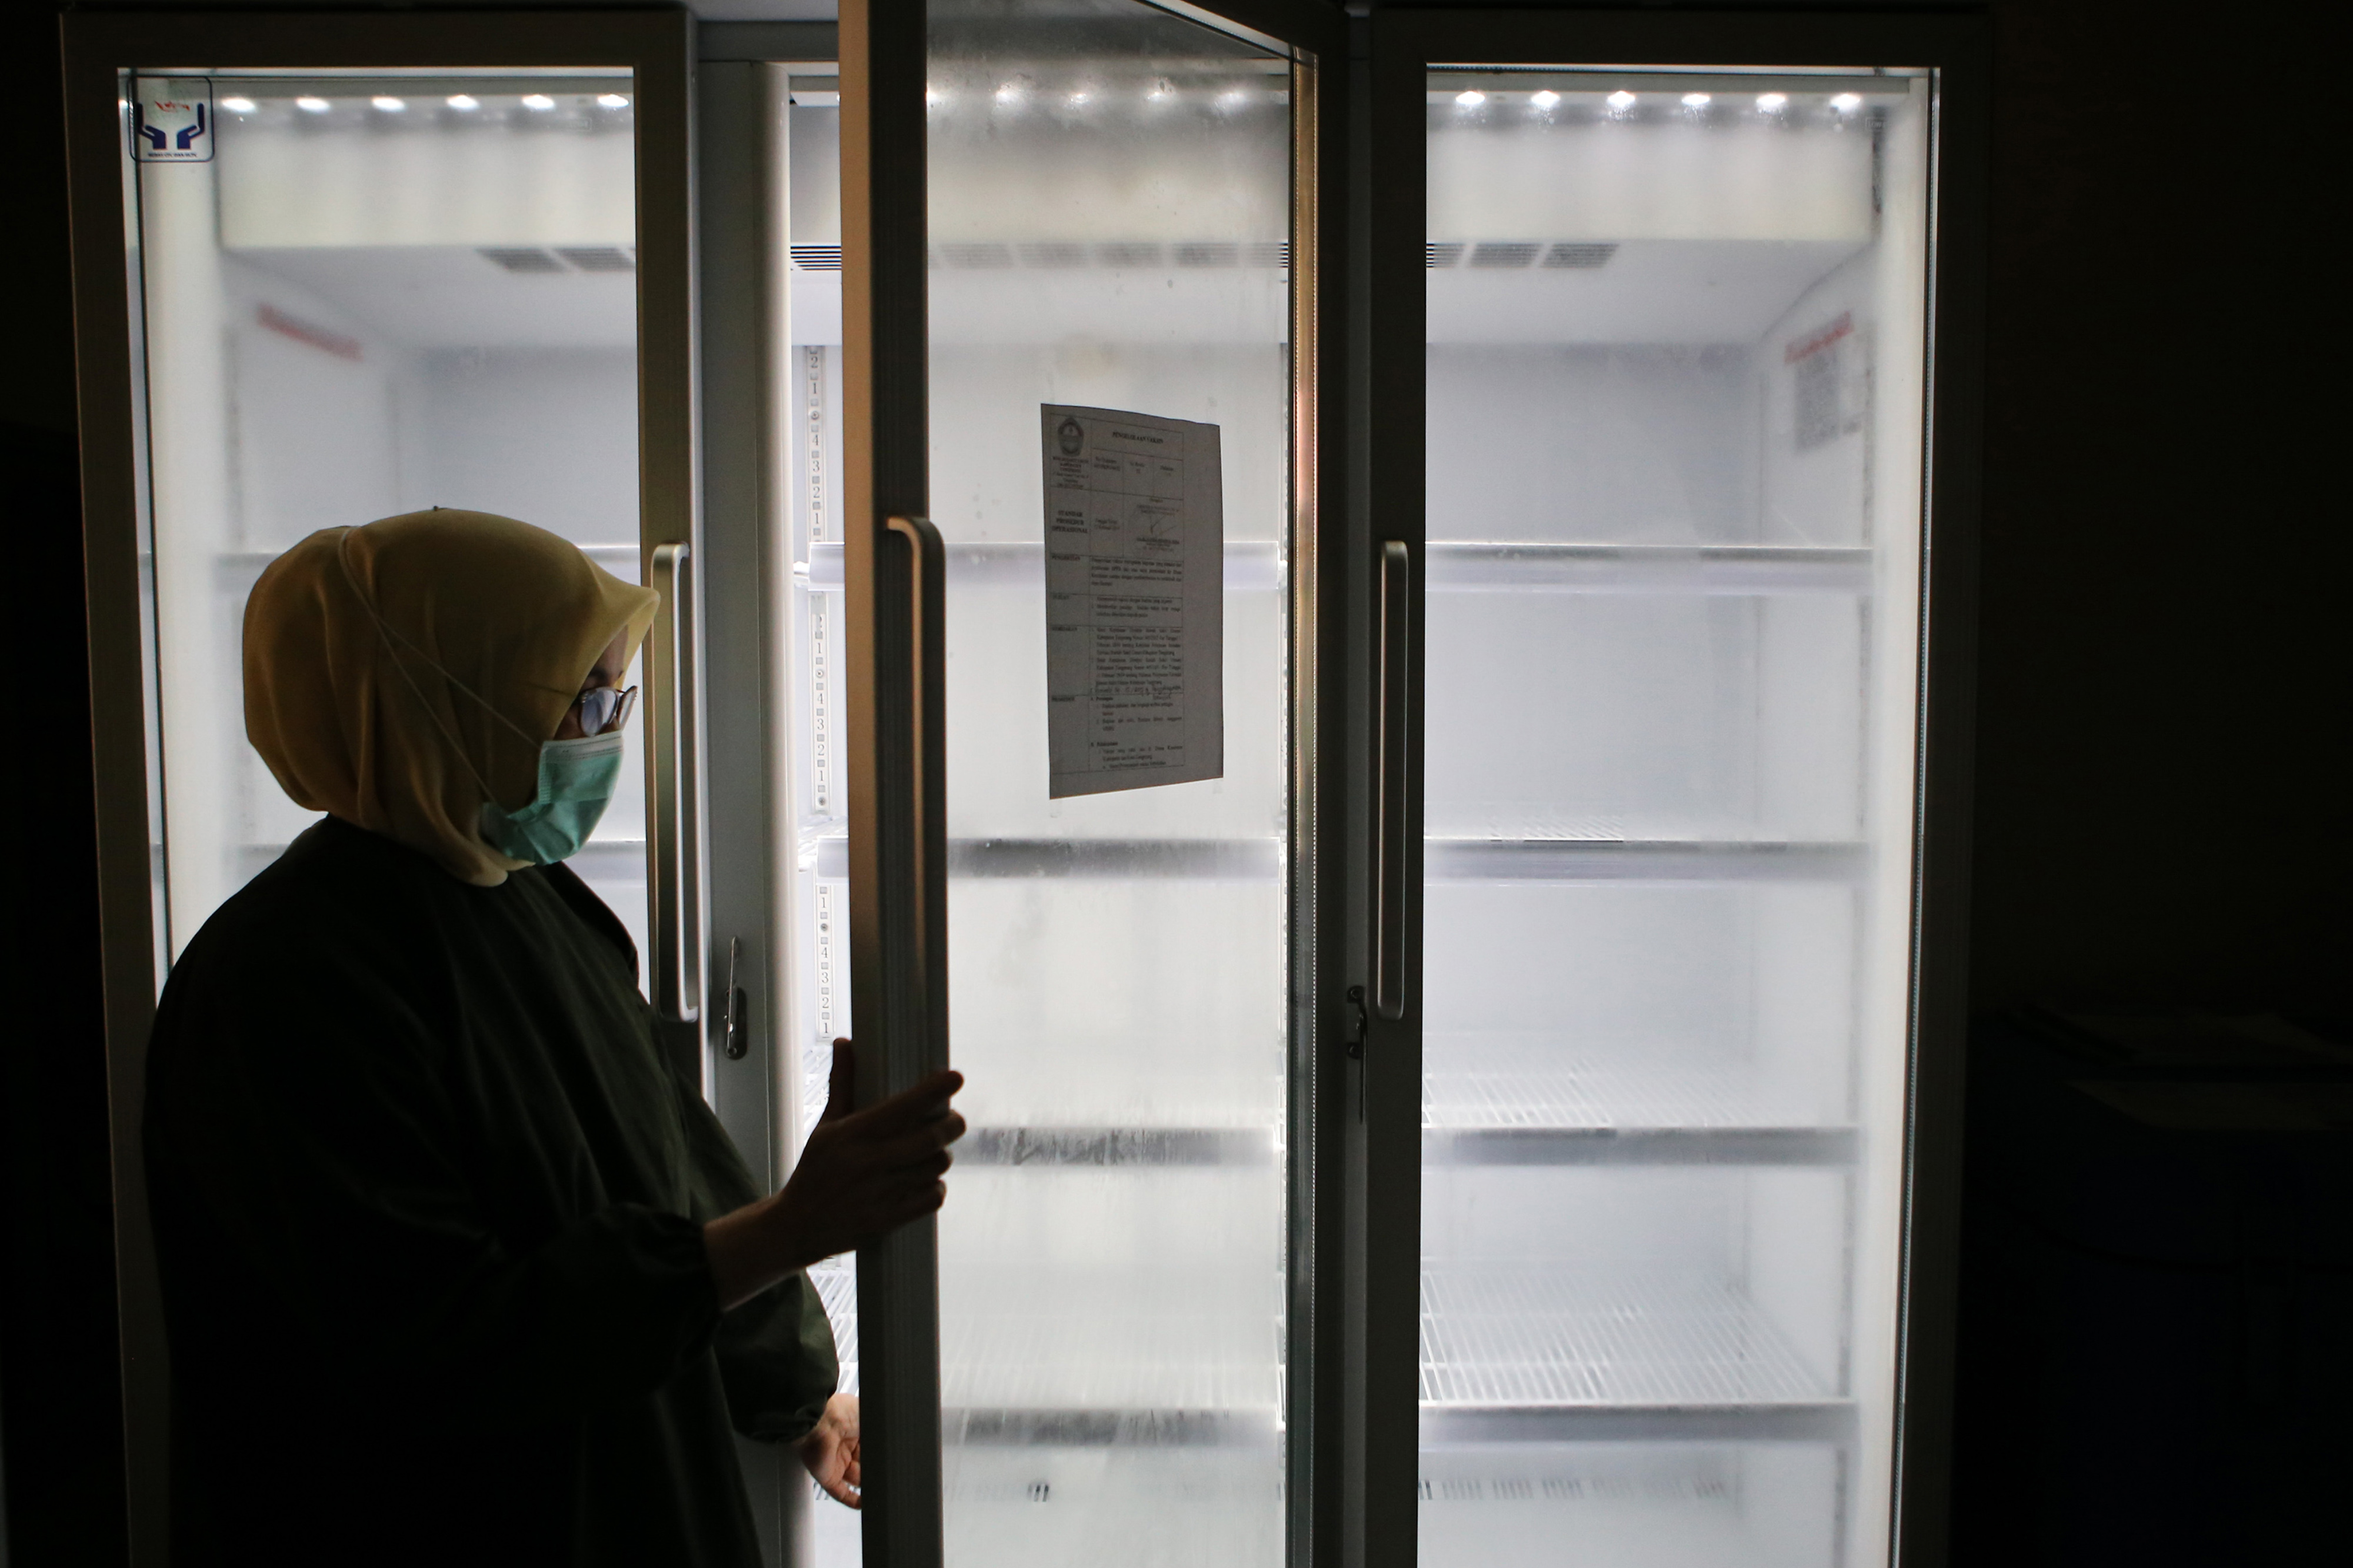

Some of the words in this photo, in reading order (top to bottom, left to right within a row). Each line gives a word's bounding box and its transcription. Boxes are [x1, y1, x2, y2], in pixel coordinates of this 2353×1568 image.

[811, 356, 818, 368] 2
[812, 434, 819, 446] 4
[812, 460, 820, 472] 3
[813, 486, 821, 498] 2
[817, 693, 824, 704] 4
[817, 719, 825, 730] 3
[818, 744, 825, 756] 2
[821, 947, 828, 958] 4
[821, 972, 829, 983] 3
[822, 997, 829, 1009] 2
